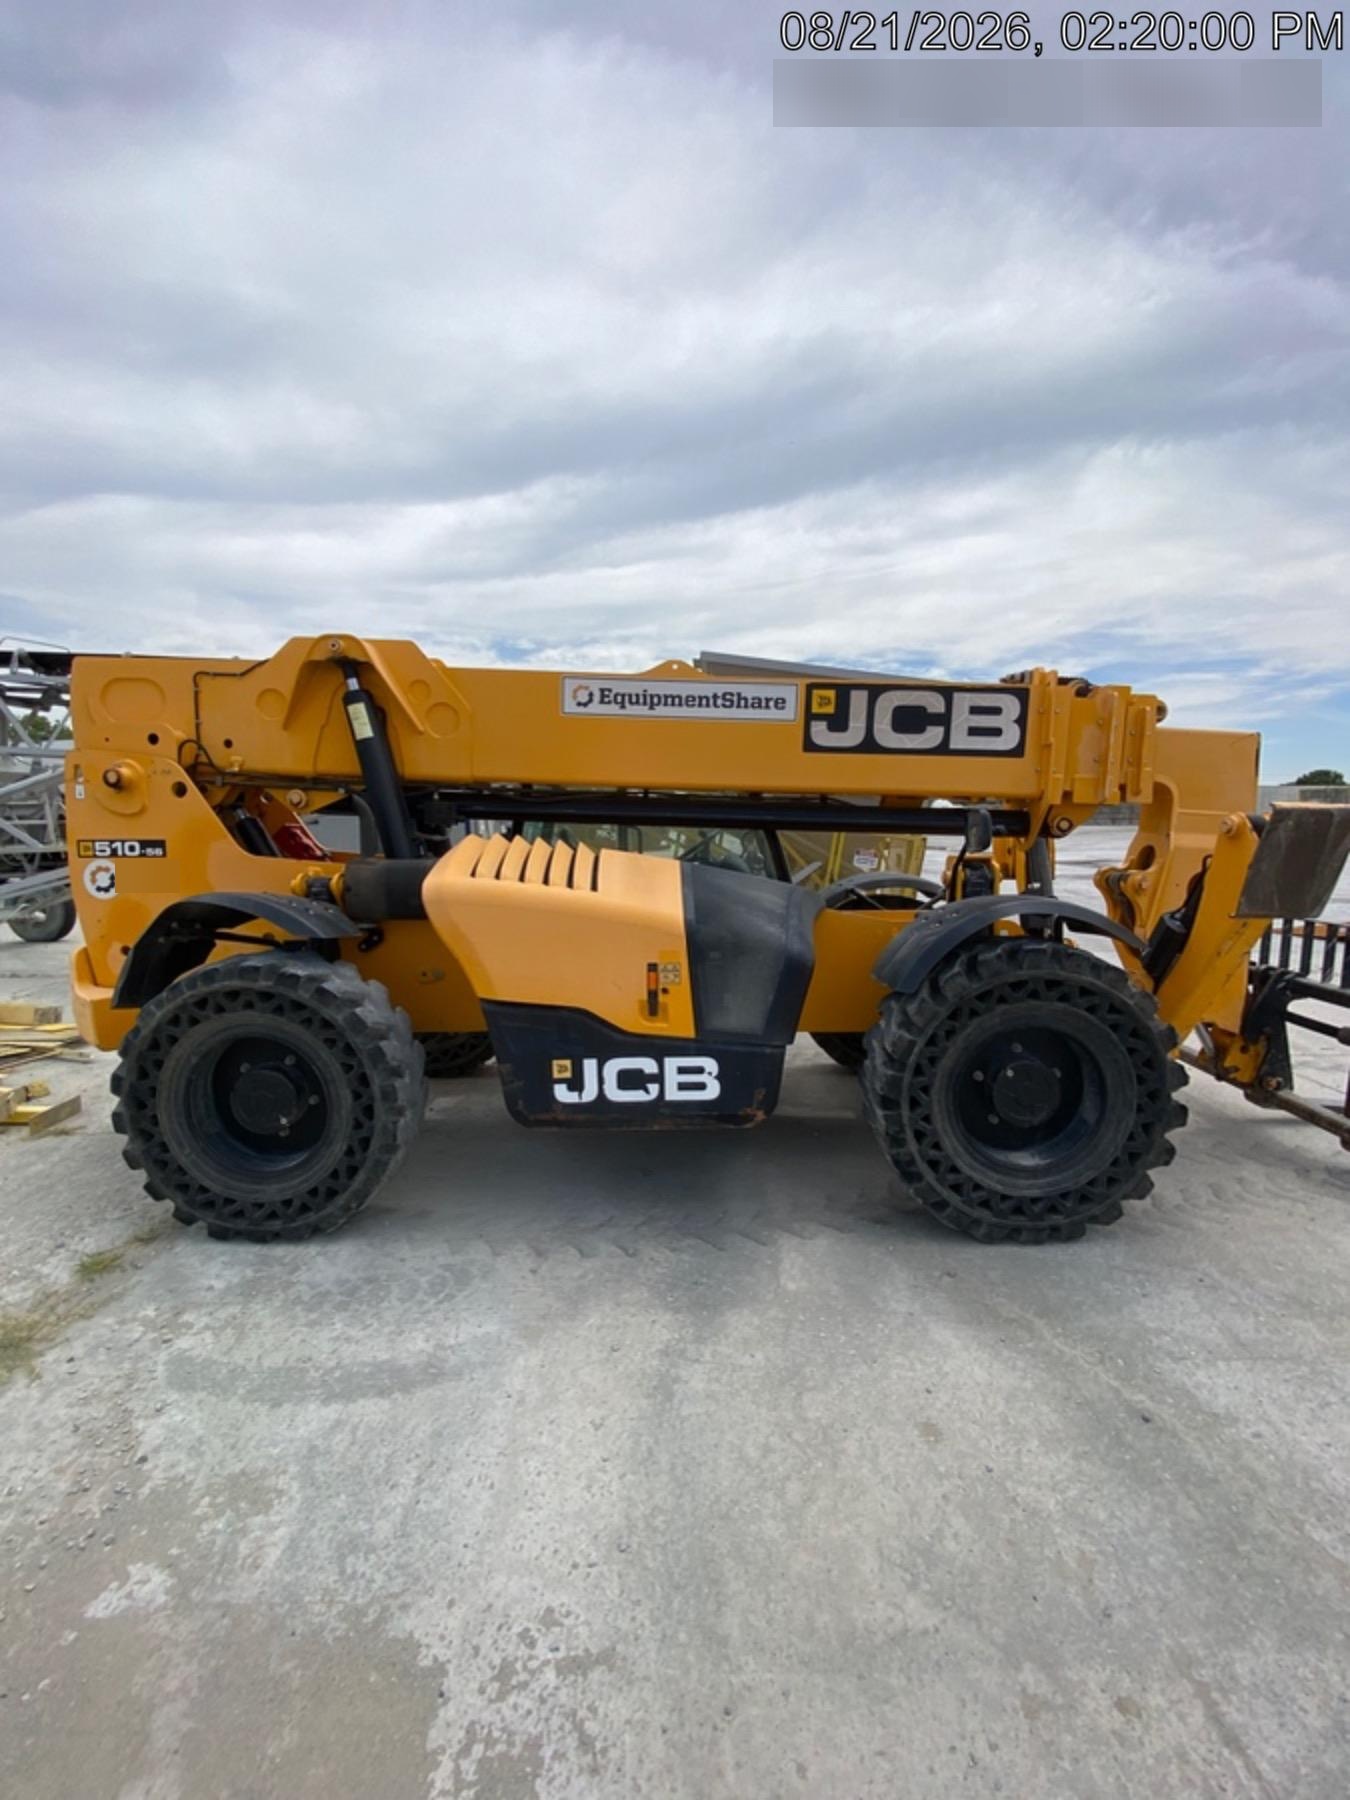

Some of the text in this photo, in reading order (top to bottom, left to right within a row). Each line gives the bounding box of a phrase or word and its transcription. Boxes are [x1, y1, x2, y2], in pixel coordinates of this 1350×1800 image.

[598, 687, 787, 711] EquipmentShare
[810, 689, 1021, 750] JCB
[553, 1056, 721, 1103] JCB
